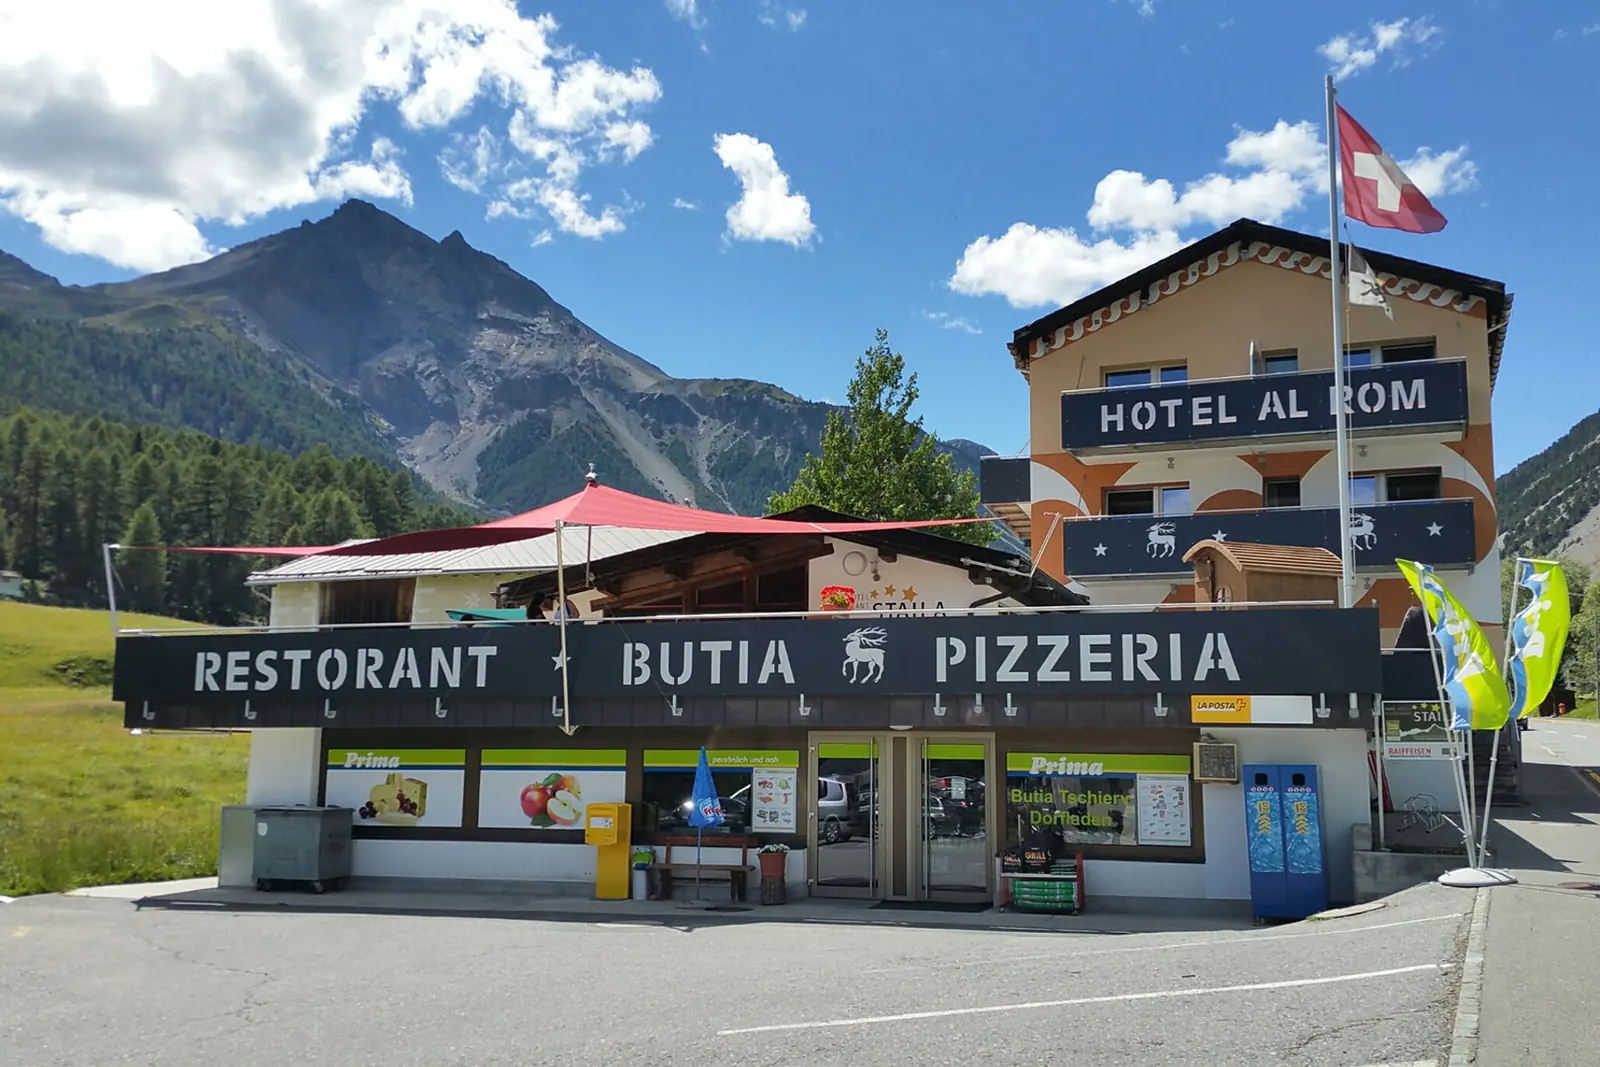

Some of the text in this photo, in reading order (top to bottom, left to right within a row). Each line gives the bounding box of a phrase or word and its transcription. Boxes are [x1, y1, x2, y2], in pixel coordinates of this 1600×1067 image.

[1101, 379, 1426, 432] HOTEL AL ROM
[623, 640, 795, 685] BUTIA
[936, 633, 1240, 682] PIZZERIA
[194, 646, 497, 691] RESTORANT
[1388, 747, 1431, 755] RAIFFEISEN
[344, 752, 400, 768] Prima
[1029, 757, 1103, 775] Prima
[1012, 789, 1131, 804] Butia Tschierv
[1031, 811, 1112, 826] Dorfladen
[1025, 851, 1047, 860] GRILL
